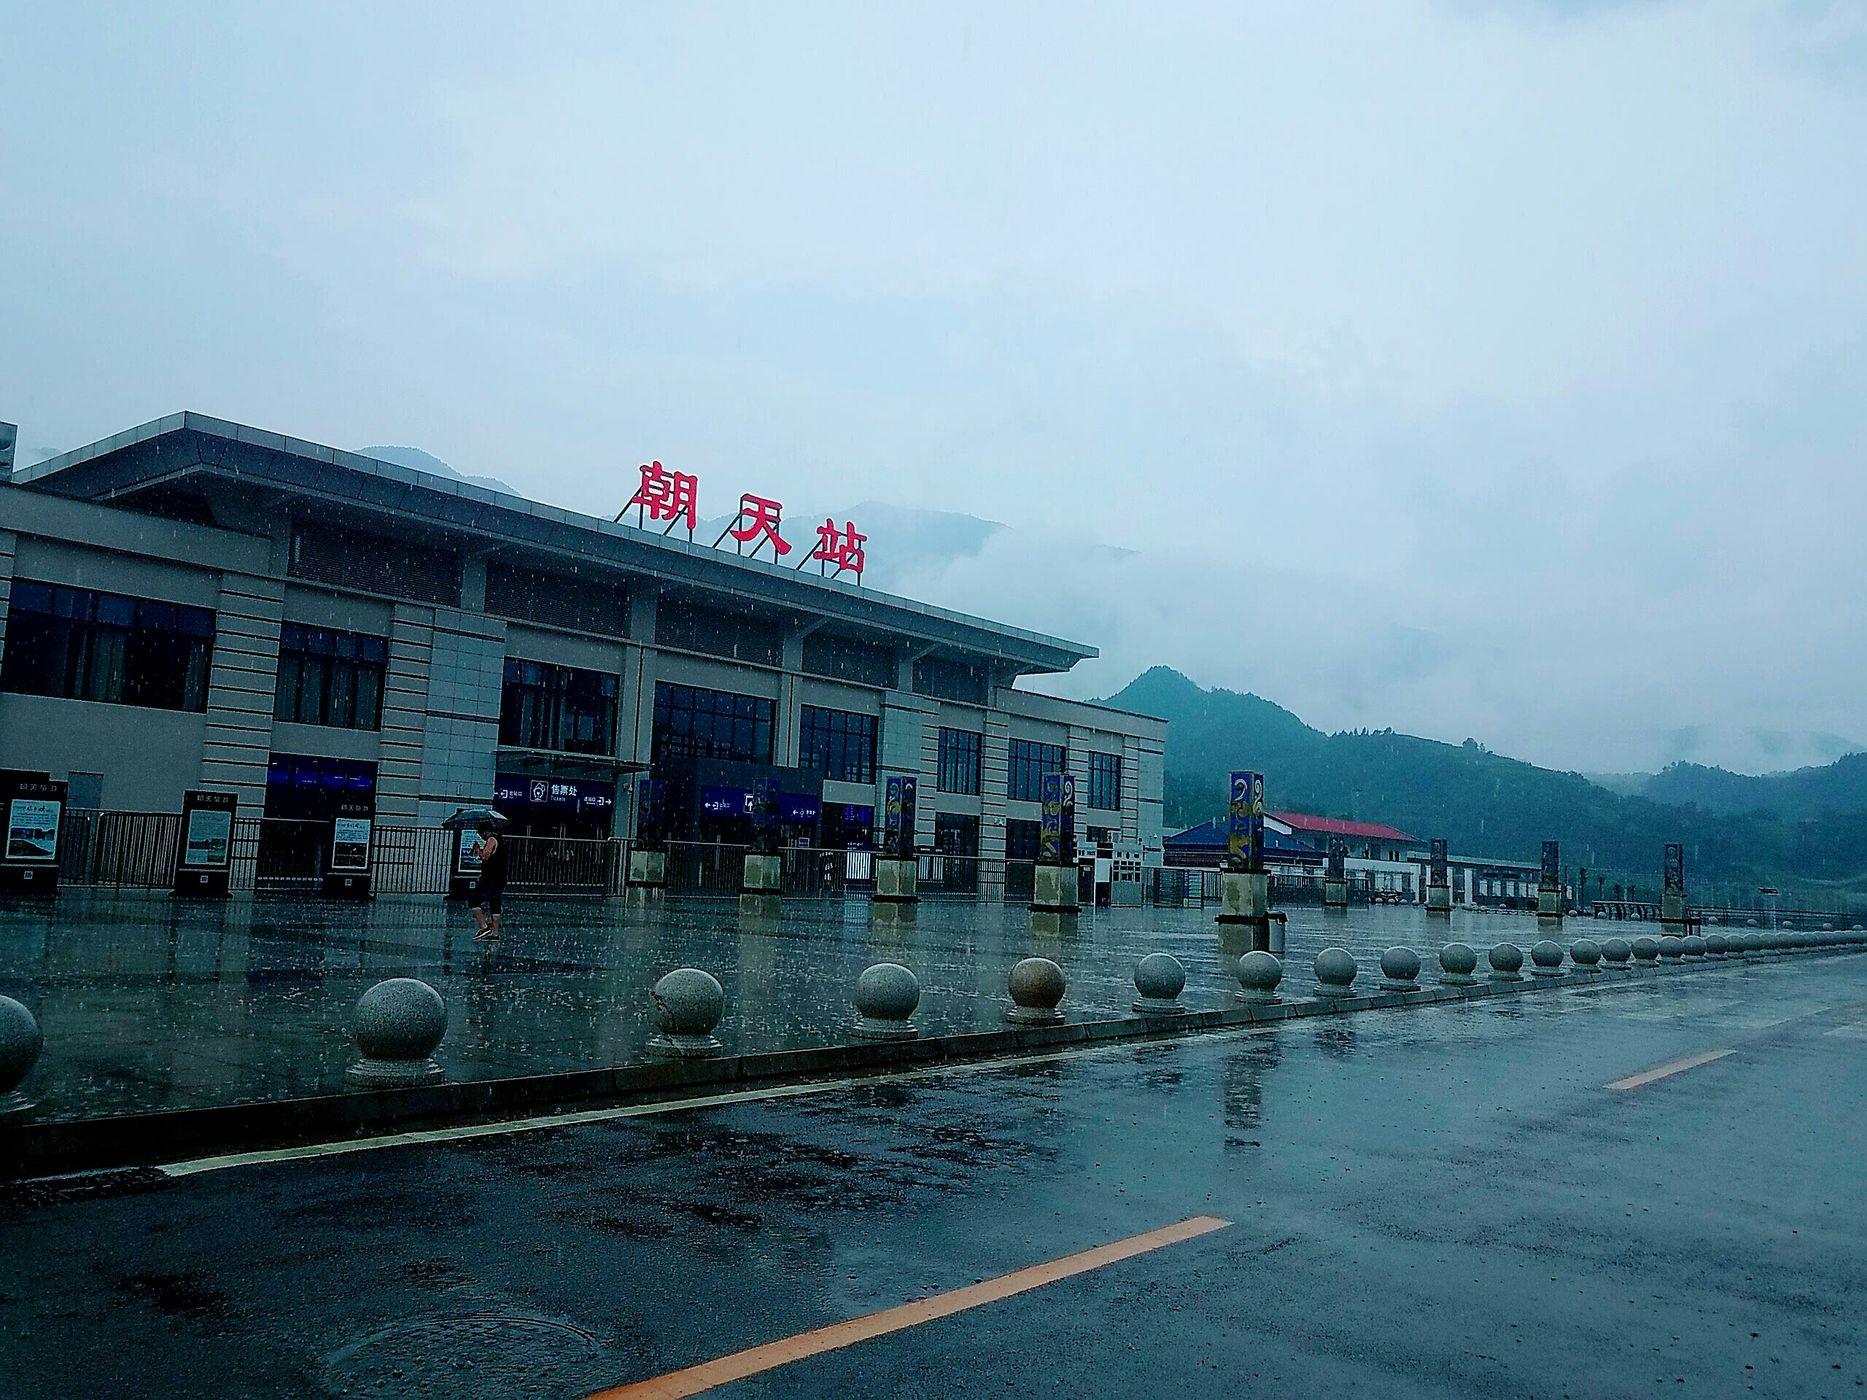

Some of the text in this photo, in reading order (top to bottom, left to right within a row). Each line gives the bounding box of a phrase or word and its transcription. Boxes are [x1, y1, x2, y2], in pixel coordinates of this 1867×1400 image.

[632, 461, 867, 574] 朝天站
[551, 784, 578, 797] 售票处
